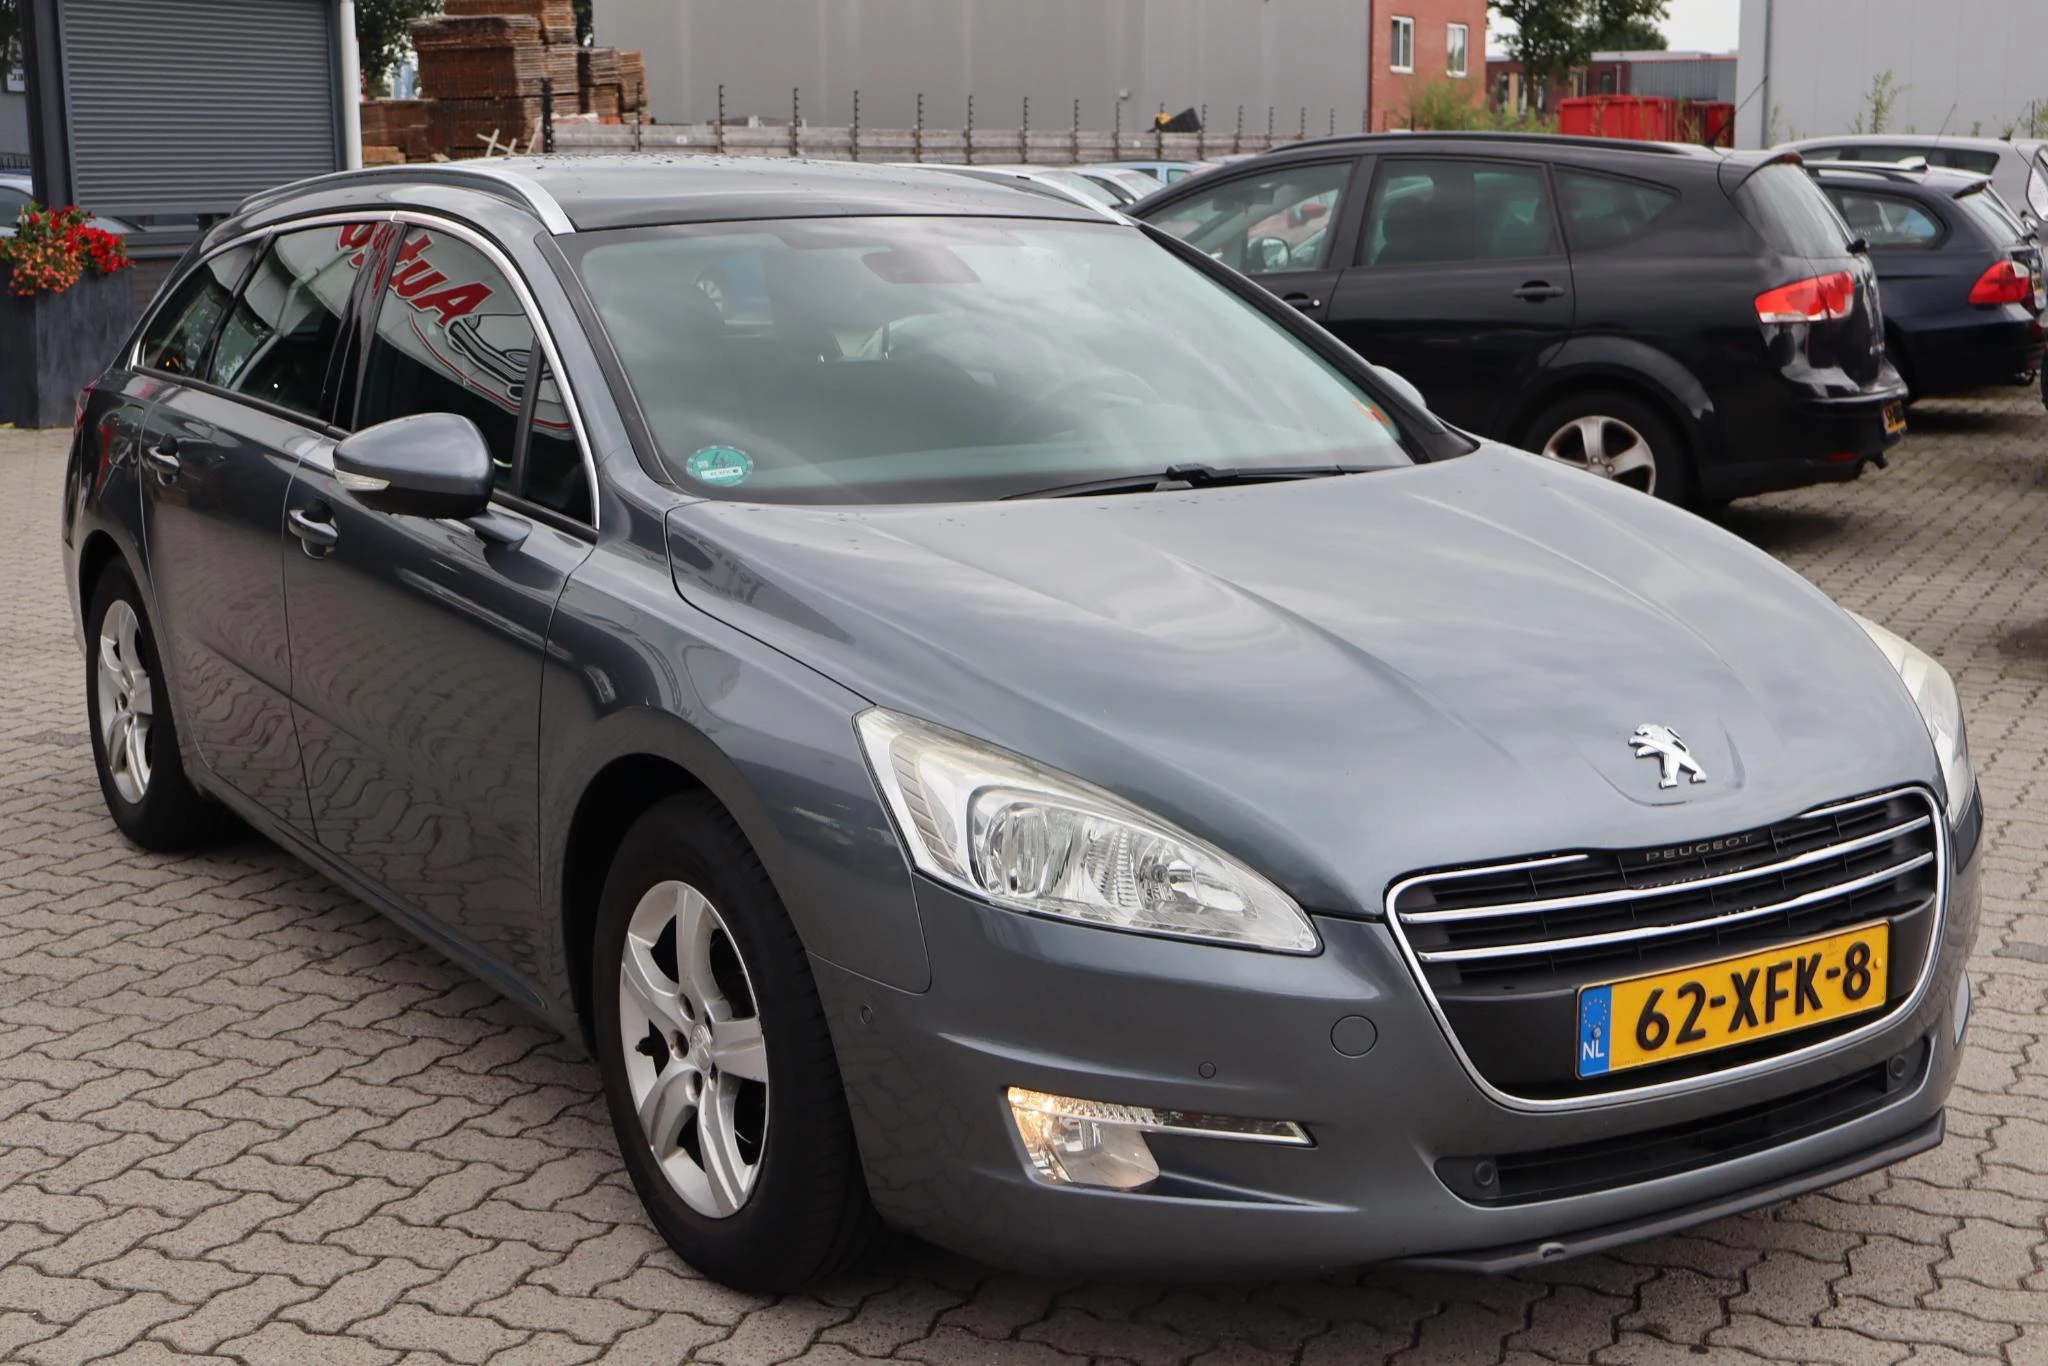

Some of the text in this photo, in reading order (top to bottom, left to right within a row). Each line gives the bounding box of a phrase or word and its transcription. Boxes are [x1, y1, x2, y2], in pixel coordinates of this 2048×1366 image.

[1645, 833, 1752, 862] PEUGEOT
[1635, 941, 1871, 1051] 62-XFK-8
[1582, 1039, 1605, 1061] NL
